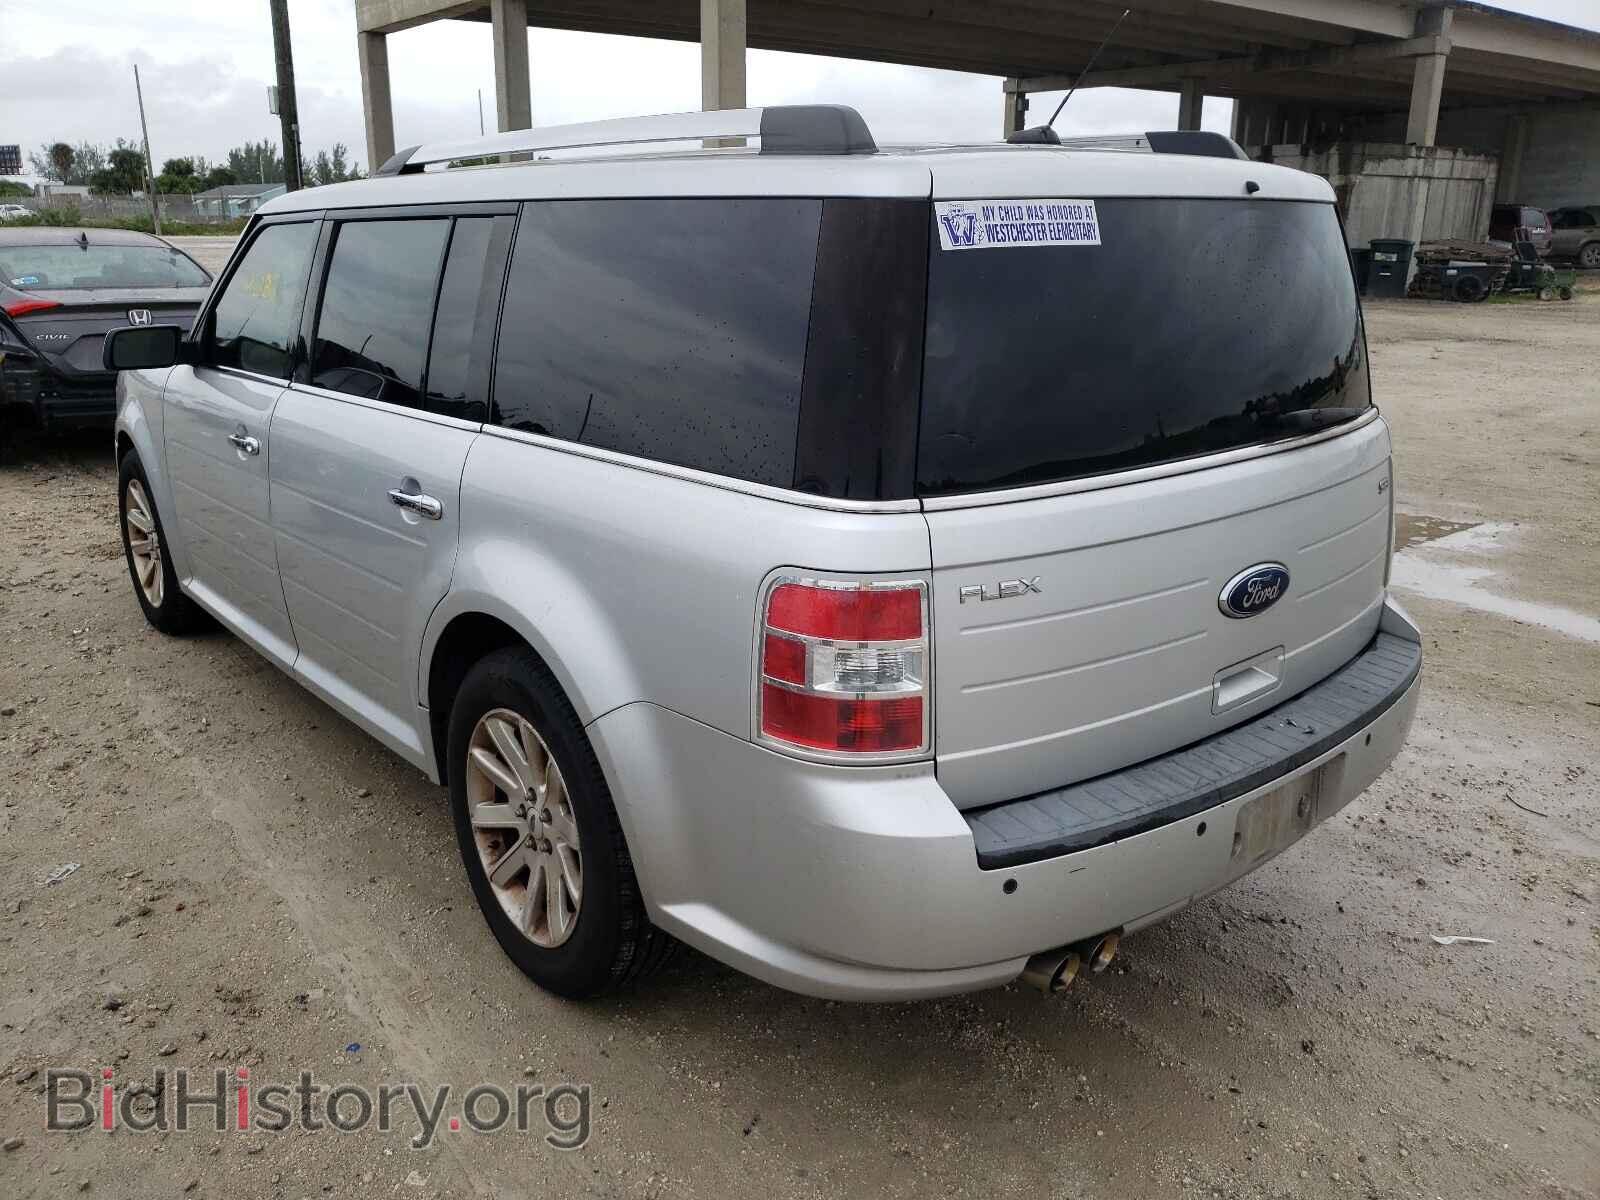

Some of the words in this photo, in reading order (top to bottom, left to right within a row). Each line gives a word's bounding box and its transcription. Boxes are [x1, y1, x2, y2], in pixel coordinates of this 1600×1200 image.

[982, 206, 995, 222] MY
[1000, 205, 1024, 222] CHILD
[1027, 204, 1045, 221] WAS
[1047, 205, 1083, 221] HONORED
[1085, 205, 1095, 220] AT
[984, 223, 1048, 243] WESTCHESTER
[1049, 222, 1097, 241] ELEMENTARY
[959, 576, 1042, 604] FLEX
[1243, 575, 1281, 608] Ford
